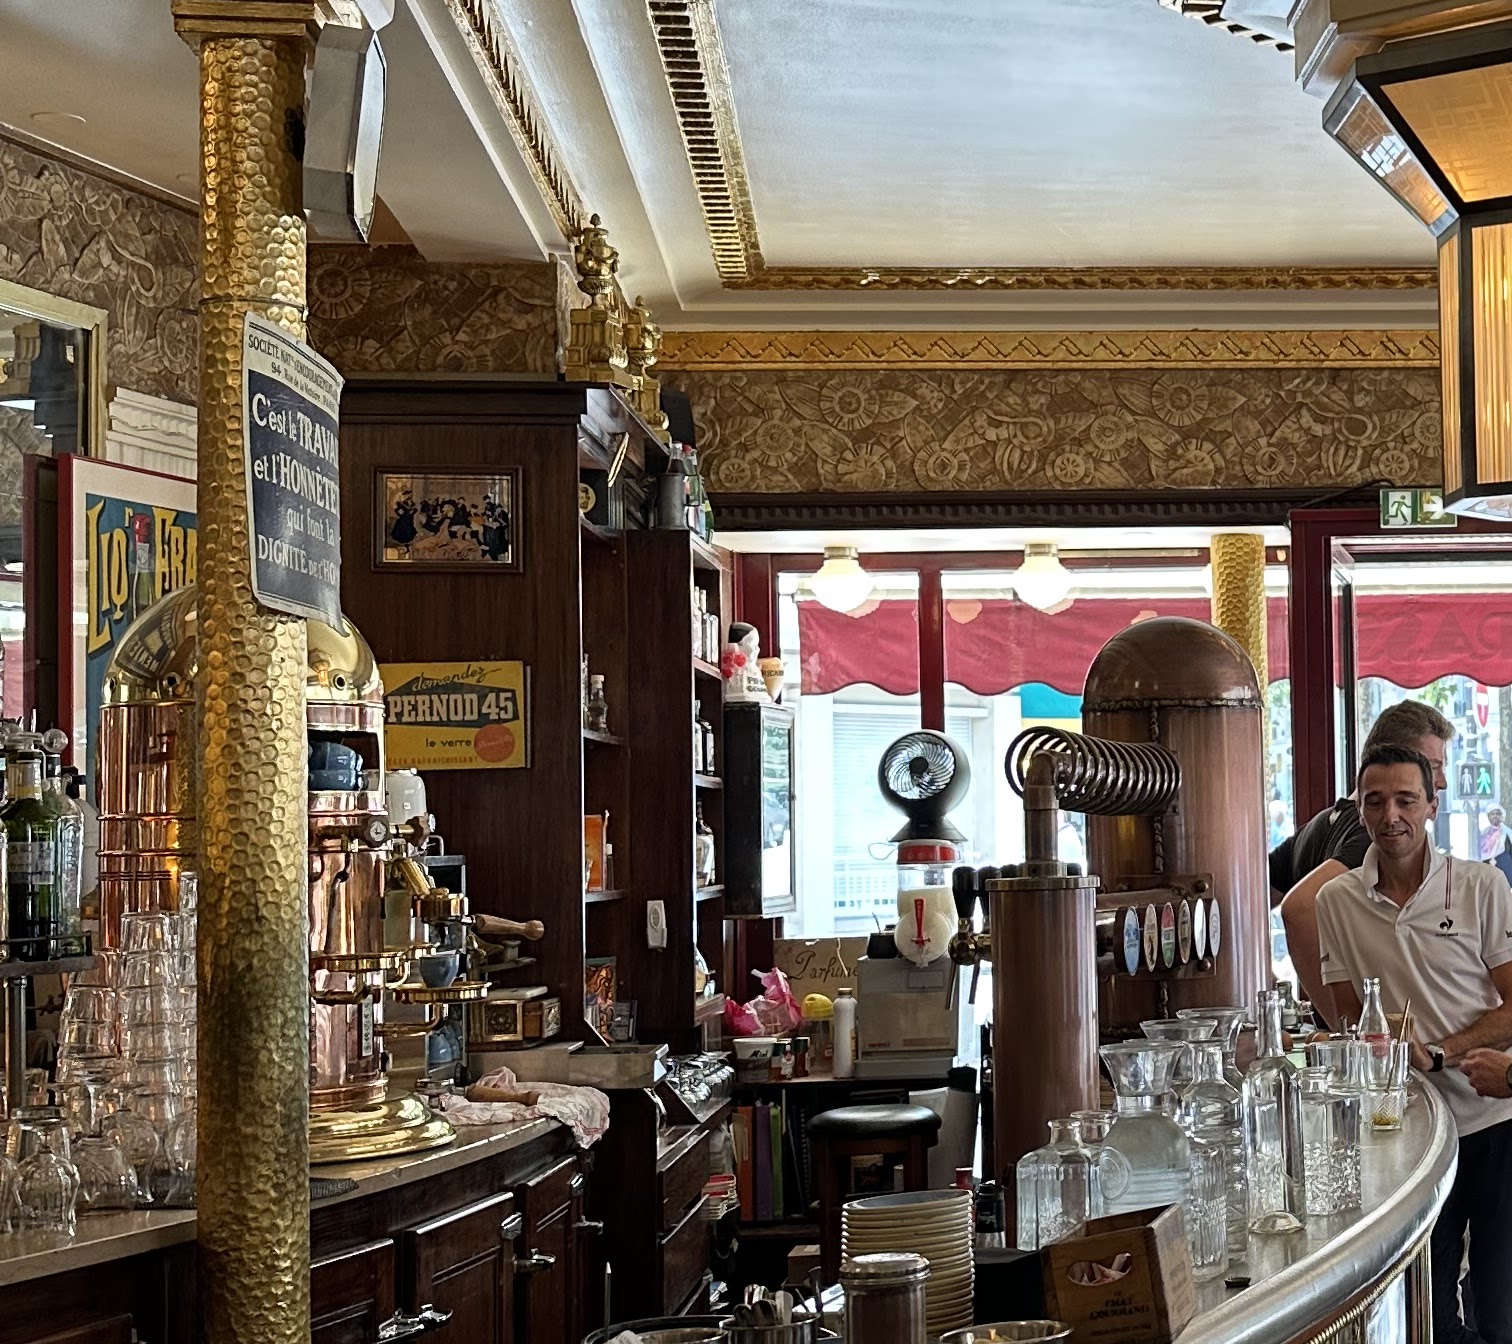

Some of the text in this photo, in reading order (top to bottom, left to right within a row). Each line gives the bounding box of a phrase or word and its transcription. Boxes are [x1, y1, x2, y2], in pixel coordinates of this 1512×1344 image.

[271, 362, 281, 376] 94
[252, 393, 287, 436] C'est
[288, 410, 297, 441] le
[254, 455, 269, 481] et
[287, 505, 335, 546] qui font la
[258, 534, 308, 574] DIGNITÉ
[412, 664, 502, 692] demandez
[387, 692, 514, 723] PERNOD 45
[425, 738, 436, 748] le
[441, 740, 472, 748] verre
